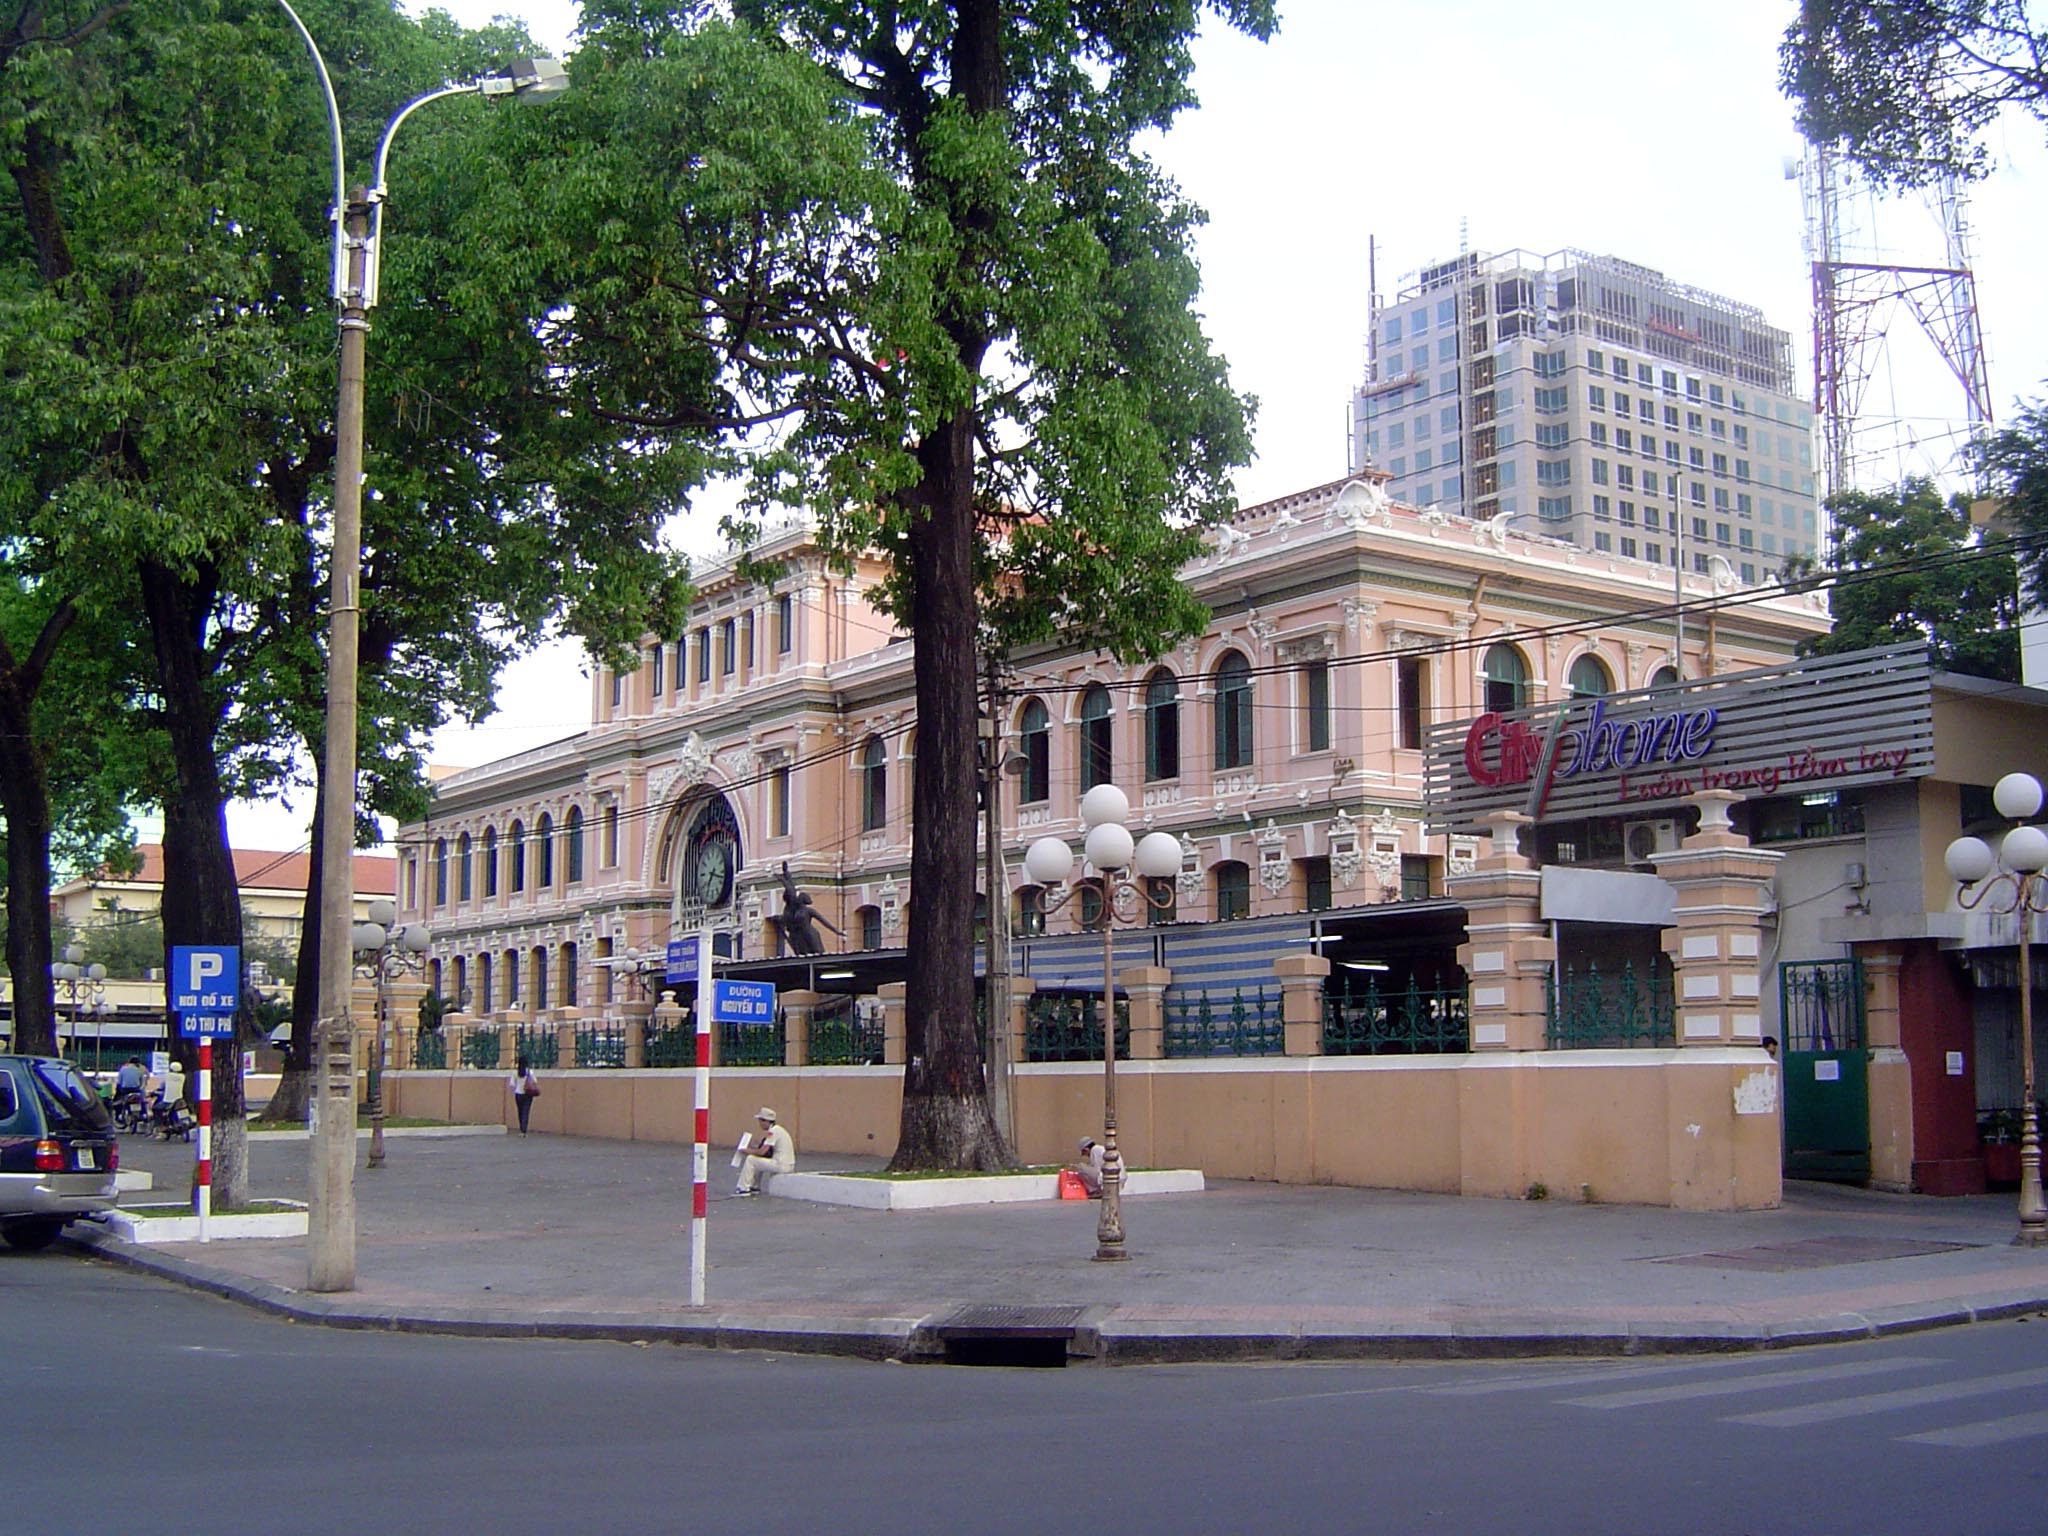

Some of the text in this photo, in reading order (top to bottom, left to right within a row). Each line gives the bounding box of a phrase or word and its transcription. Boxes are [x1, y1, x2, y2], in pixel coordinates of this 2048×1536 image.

[1702, 766, 1781, 794] trong
[1859, 746, 1909, 777] tay
[190, 952, 223, 991] P
[220, 995, 234, 1007] XE
[755, 1002, 768, 1015] DU
[185, 1013, 197, 1032] CÓ
[199, 1017, 215, 1032] THU
